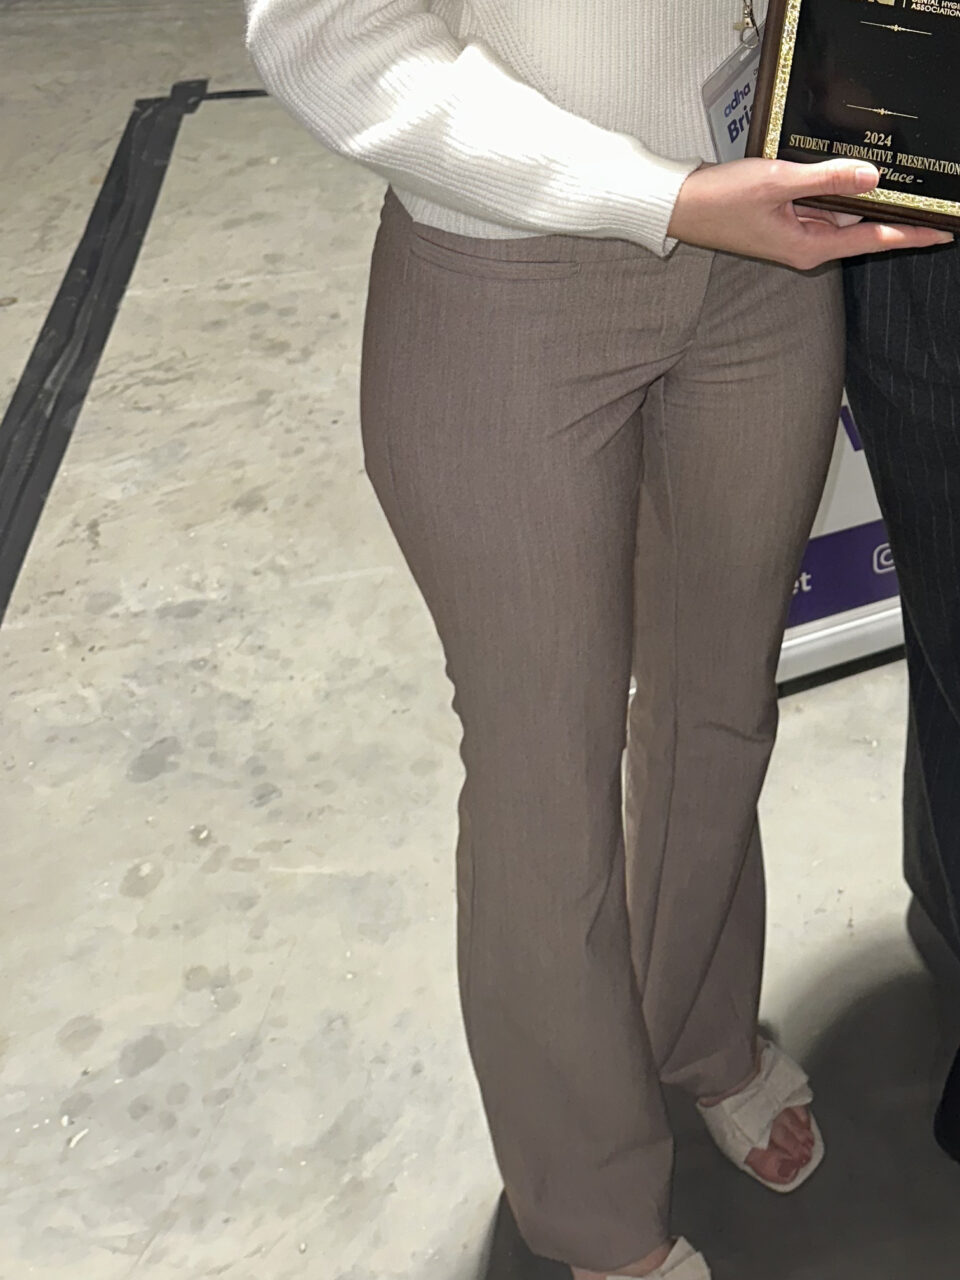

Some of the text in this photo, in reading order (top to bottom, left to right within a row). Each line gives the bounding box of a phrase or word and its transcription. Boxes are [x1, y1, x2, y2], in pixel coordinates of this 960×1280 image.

[723, 82, 751, 118] adha
[727, 104, 754, 144] Bri
[864, 130, 893, 148] 2024
[789, 133, 830, 153] STUDENT
[832, 141, 894, 164] INFORMATIVE
[879, 166, 915, 184] Place
